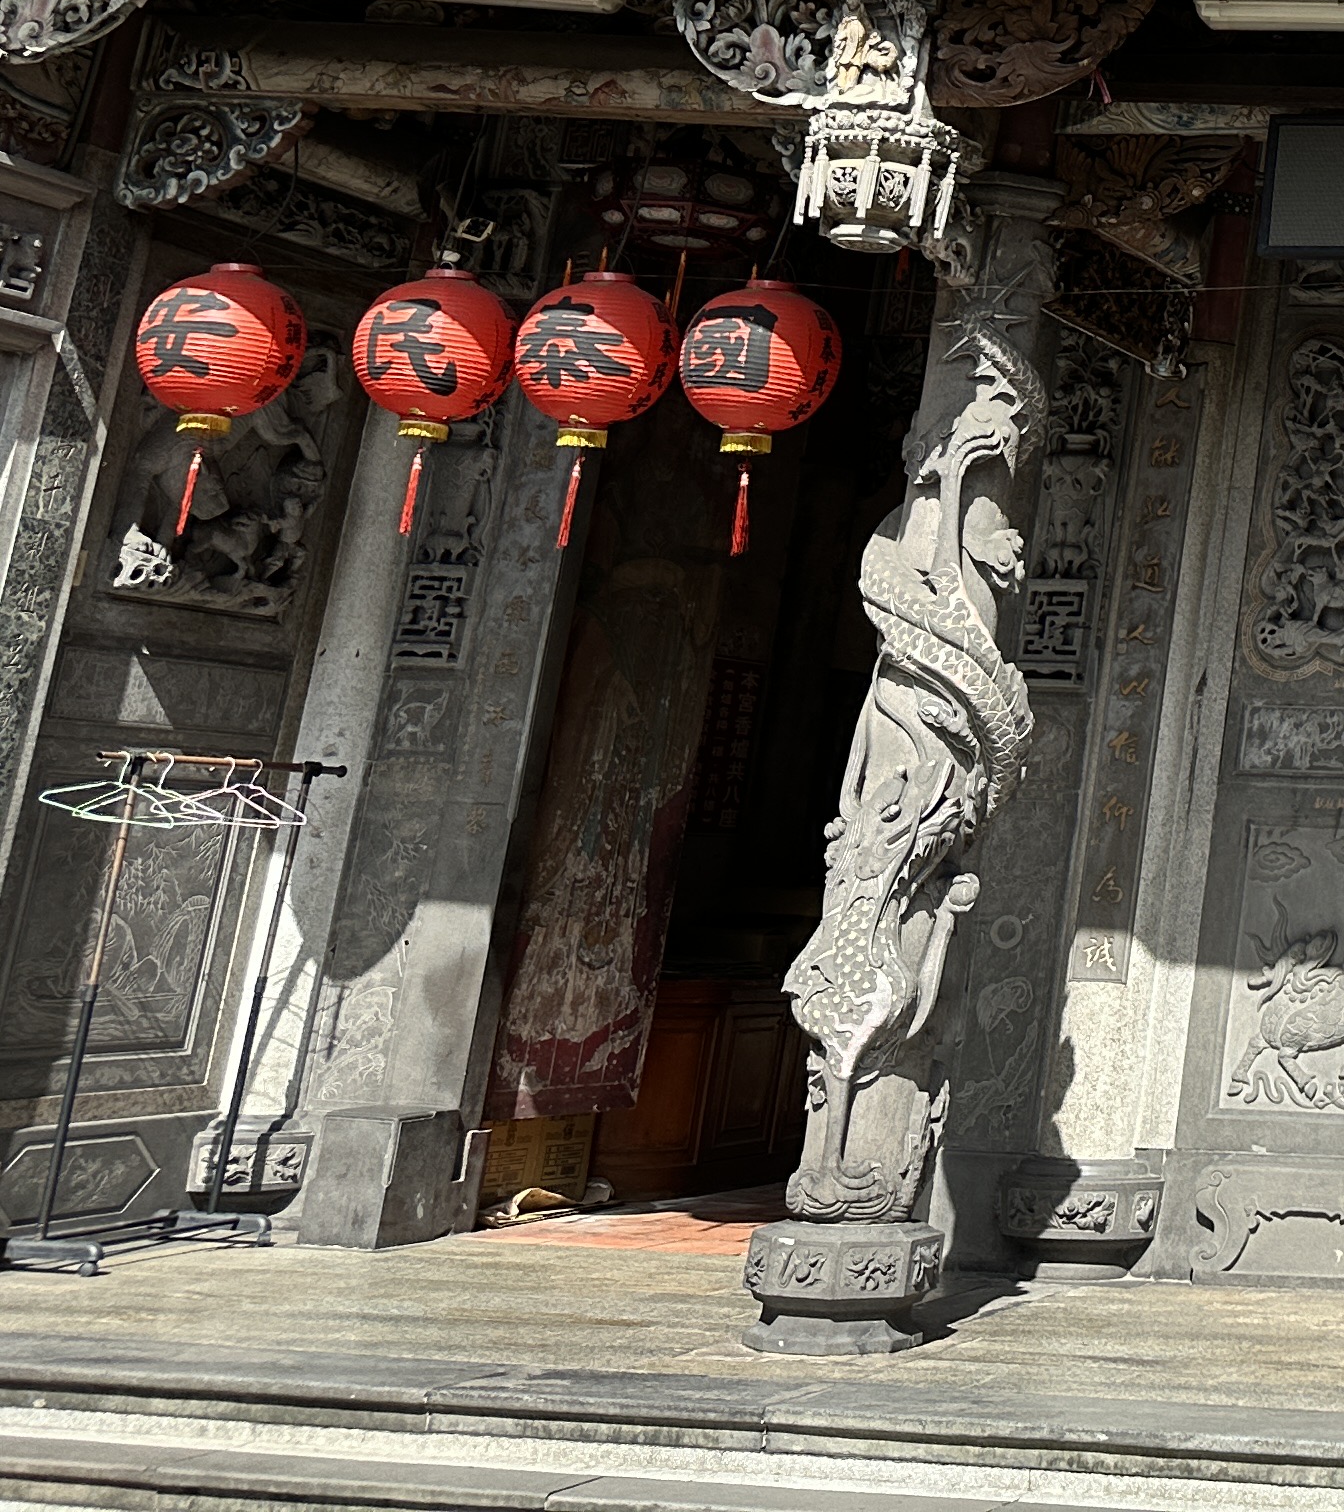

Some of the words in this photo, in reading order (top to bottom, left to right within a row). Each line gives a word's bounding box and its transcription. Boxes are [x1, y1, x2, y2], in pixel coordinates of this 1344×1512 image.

[147, 289, 240, 378] 安
[367, 299, 460, 396] 民
[519, 296, 632, 388] 泰
[679, 305, 779, 391] 國
